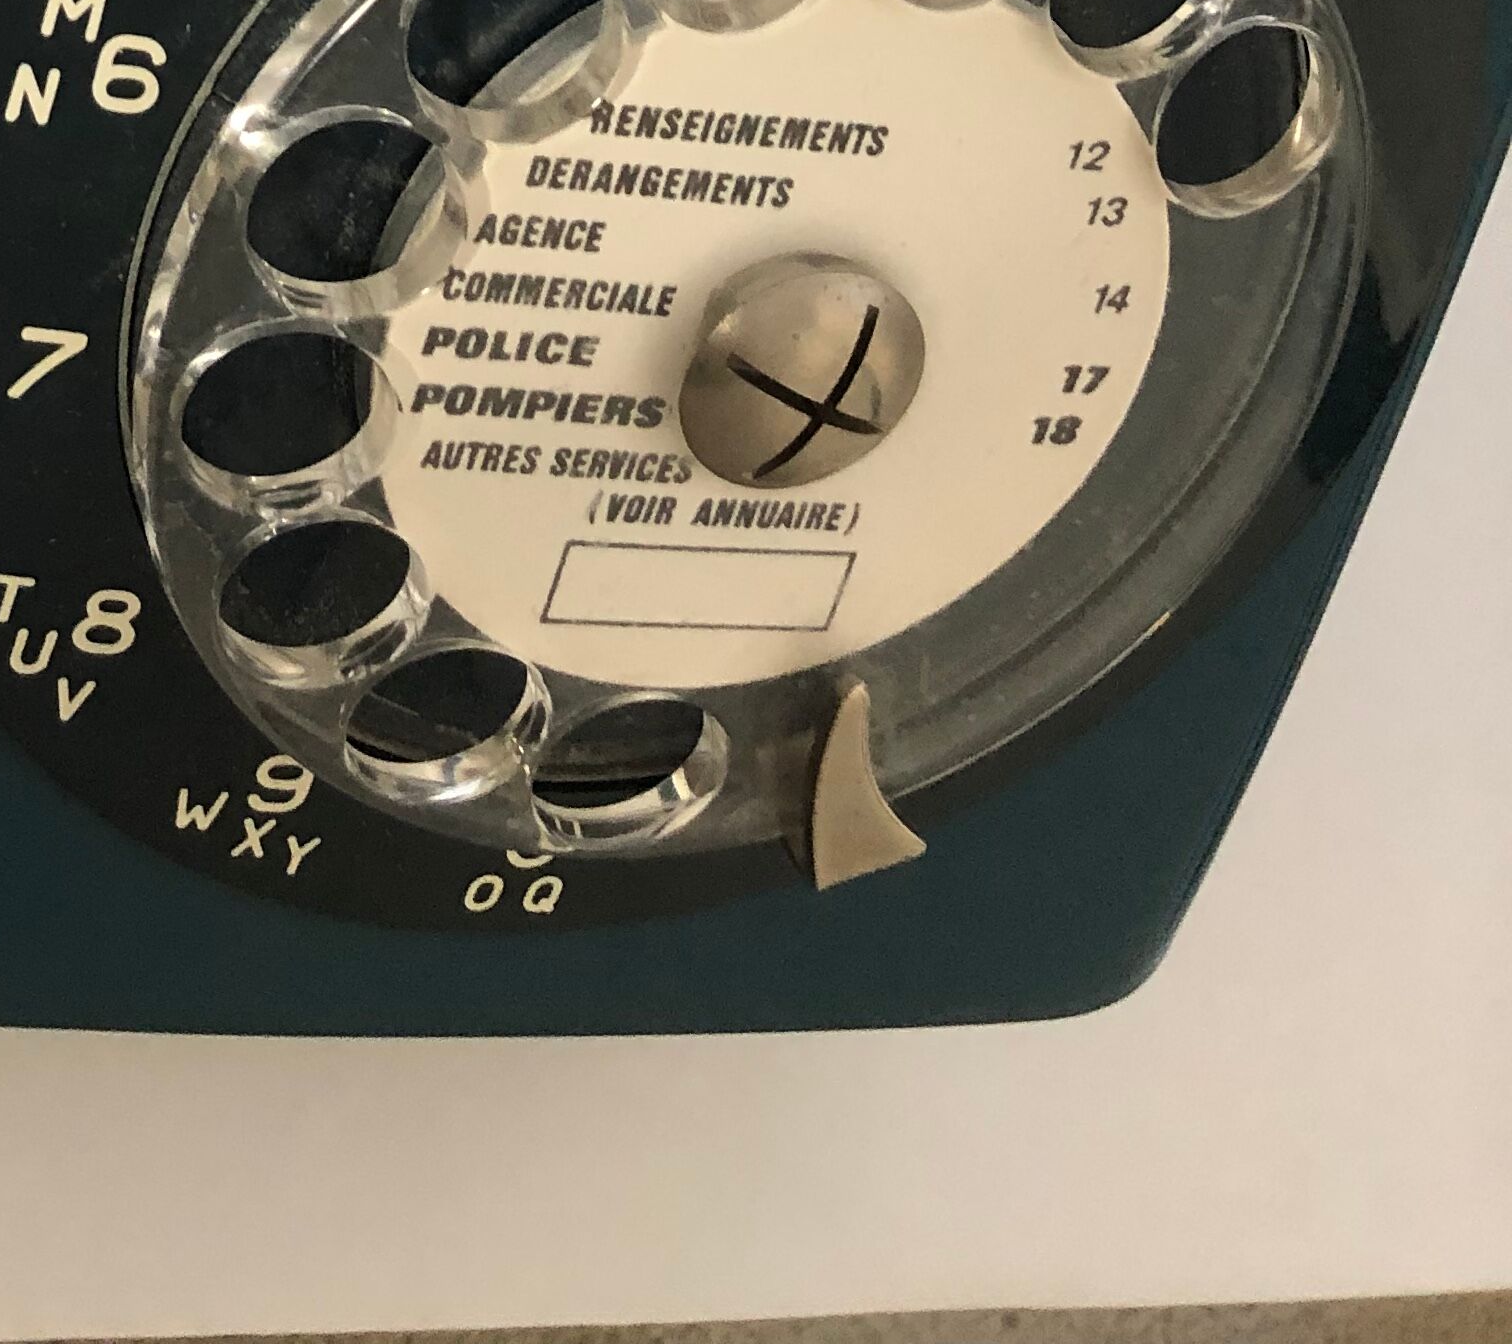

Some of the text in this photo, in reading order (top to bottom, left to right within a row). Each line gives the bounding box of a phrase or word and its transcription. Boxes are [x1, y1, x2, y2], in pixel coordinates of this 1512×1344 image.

[90, 32, 168, 116] 6
[590, 101, 889, 157] RENSEIGNEMENTS
[1068, 140, 1111, 171] 12
[526, 155, 794, 208] DERANGEMENTS
[474, 213, 607, 253] AGENCE
[1088, 196, 1128, 227] 13
[443, 268, 678, 318] COMMERCIALE
[1093, 284, 1131, 314] 14
[5, 325, 90, 400] 7
[421, 325, 600, 367] POLICE
[1062, 364, 1111, 394] 17
[411, 382, 667, 429] POMPIERS
[1031, 415, 1083, 445] 18
[420, 440, 693, 484] AUTRES SERVICES
[588, 488, 860, 536] (VOIR ANNUAIRE)
[70, 588, 143, 656] 8
[246, 753, 316, 814] 9
